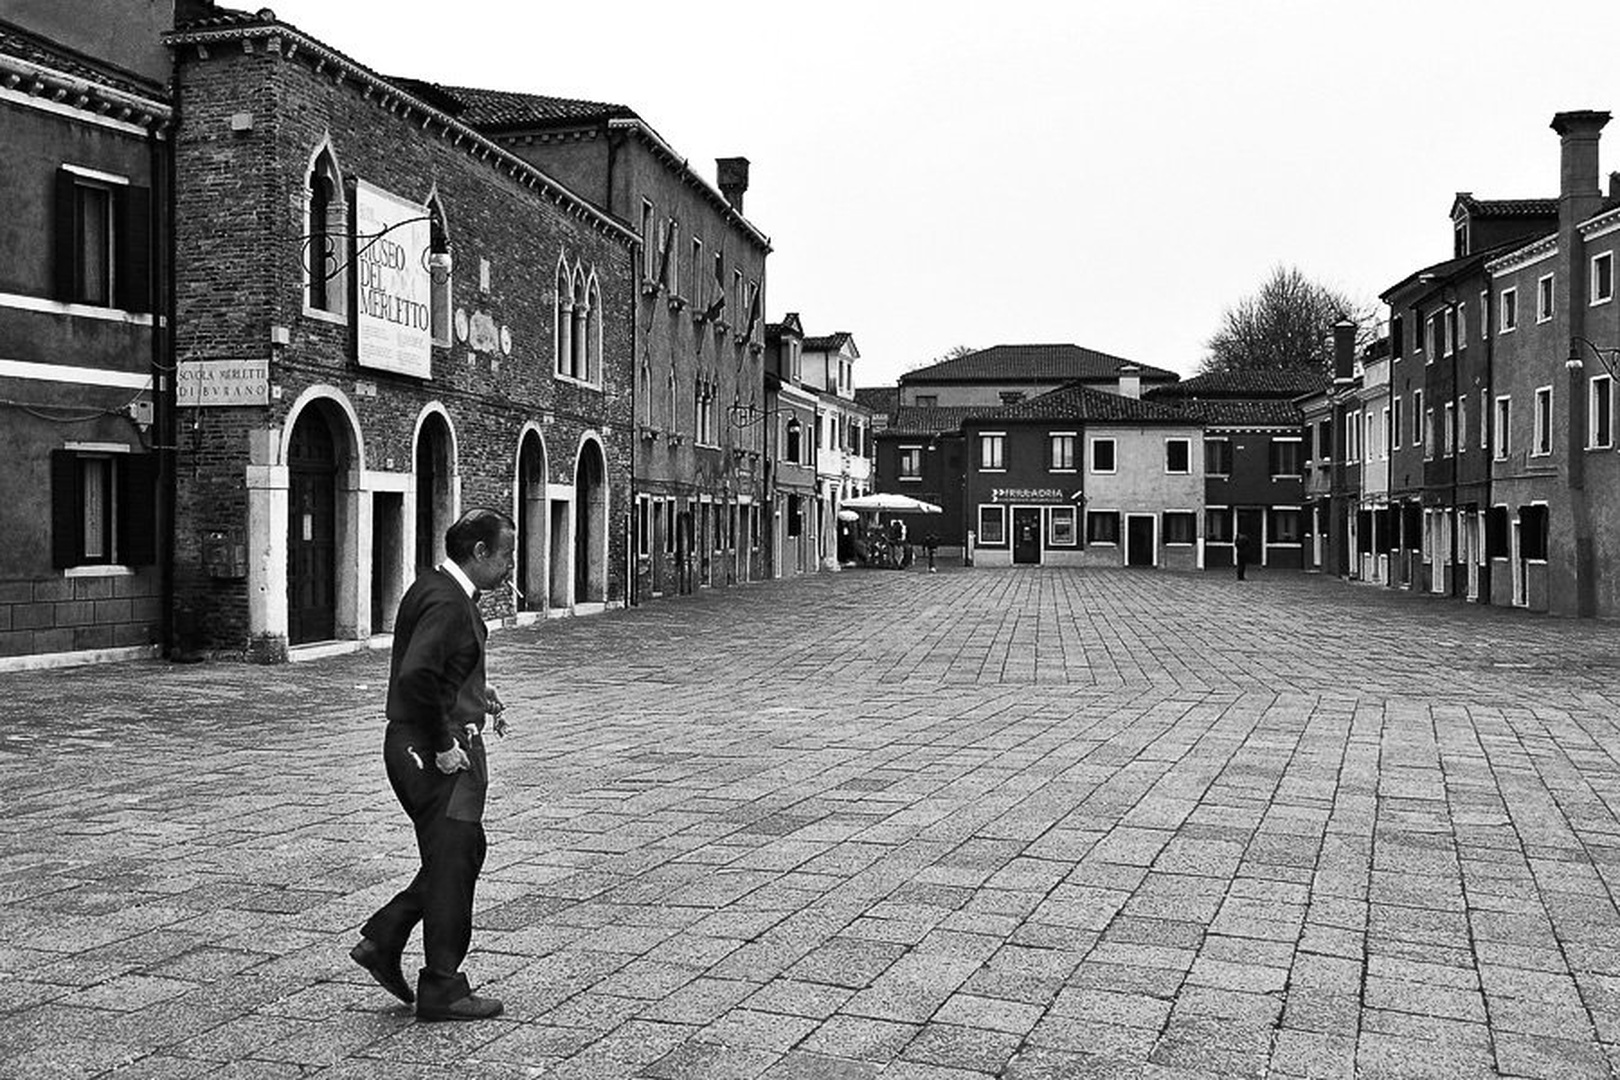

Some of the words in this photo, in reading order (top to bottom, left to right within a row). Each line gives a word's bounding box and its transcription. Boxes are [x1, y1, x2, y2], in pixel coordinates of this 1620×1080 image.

[359, 230, 406, 272] MUSEO
[359, 258, 386, 292] DEL
[359, 285, 430, 332] MERLETTO
[178, 386, 194, 398] DI
